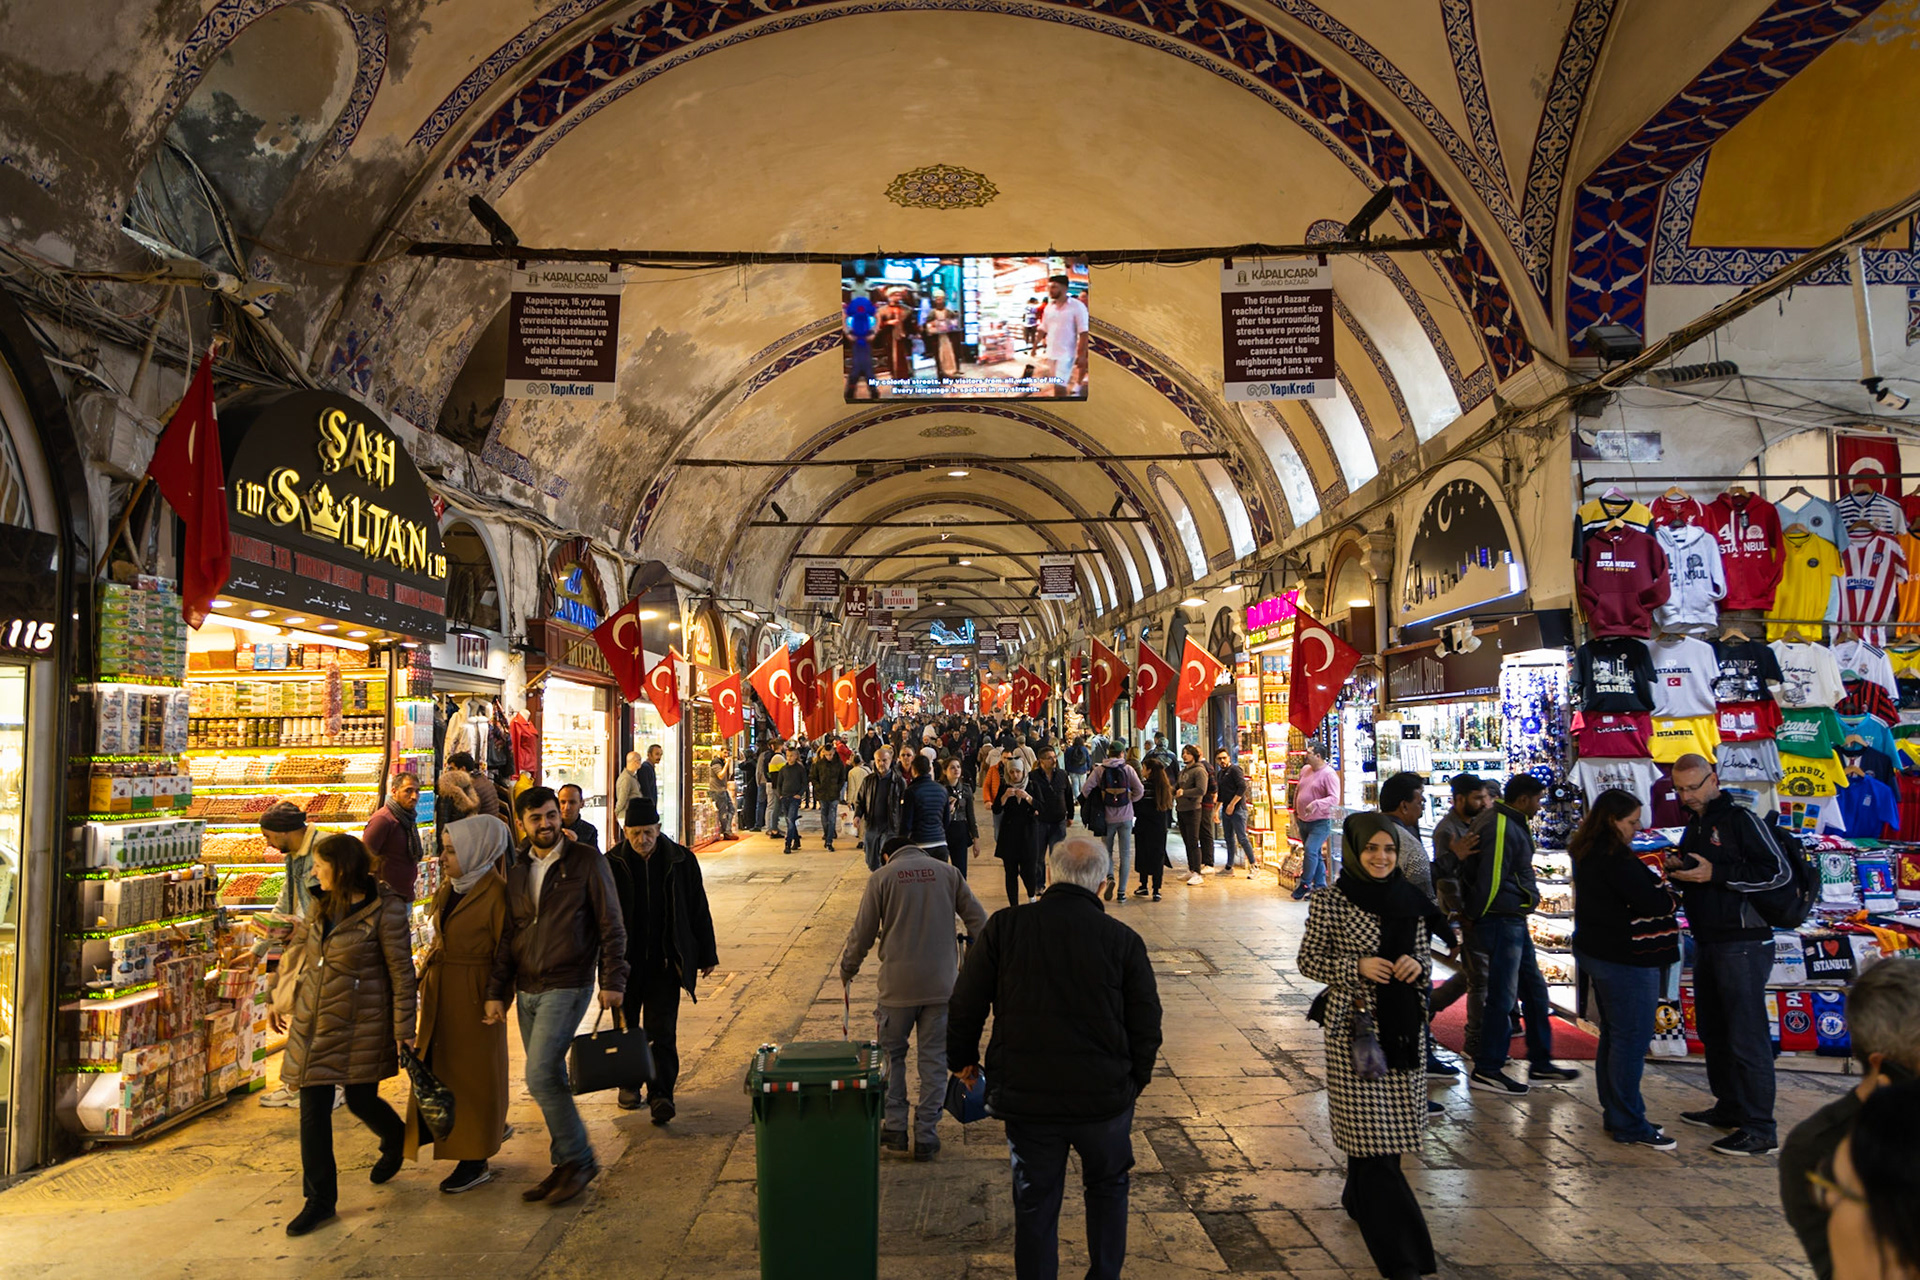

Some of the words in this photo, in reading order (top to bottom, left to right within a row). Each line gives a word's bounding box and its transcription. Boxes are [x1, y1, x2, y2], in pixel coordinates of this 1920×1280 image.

[526, 296, 569, 307] Kapalıçarşı,
[1244, 297, 1258, 305] The
[1260, 296, 1282, 304] Grand
[1284, 295, 1310, 303] Bazaar
[523, 306, 553, 315] itibaren
[555, 307, 606, 316] bedestenlerin
[1232, 307, 1263, 315] reached
[1265, 306, 1275, 314] its
[1277, 305, 1306, 315] present
[1308, 304, 1323, 312] size
[520, 317, 568, 325] çevresindeki
[569, 318, 609, 326] sokakların
[1237, 317, 1256, 325] after
[1272, 315, 1319, 325] surrounding
[520, 326, 550, 335] üzerinin
[552, 327, 596, 338] kapatılması
[1236, 327, 1264, 335] streets
[1287, 325, 1320, 335] provided
[523, 336, 560, 346] çevredeki
[561, 338, 592, 346] hanların
[594, 338, 603, 346] da
[1238, 337, 1273, 346] overhead
[1299, 335, 1319, 344] using
[531, 347, 549, 355] dahil
[551, 347, 594, 357] edilmesiyle
[1279, 346, 1293, 354] and
[525, 356, 557, 366] bugünkü
[560, 357, 598, 366] sınırlarına
[1236, 357, 1281, 367] neighboring
[1283, 356, 1302, 364] hans
[541, 367, 581, 377] ulaşmıştır.
[1246, 367, 1286, 377] integrated
[1288, 366, 1303, 374] into
[1305, 365, 1313, 373] it.
[915, 387, 949, 395] language
[324, 408, 395, 487] ŞAH
[846, 602, 865, 611] WC
[9, 618, 55, 649] 115
[897, 869, 934, 879] UNITED
